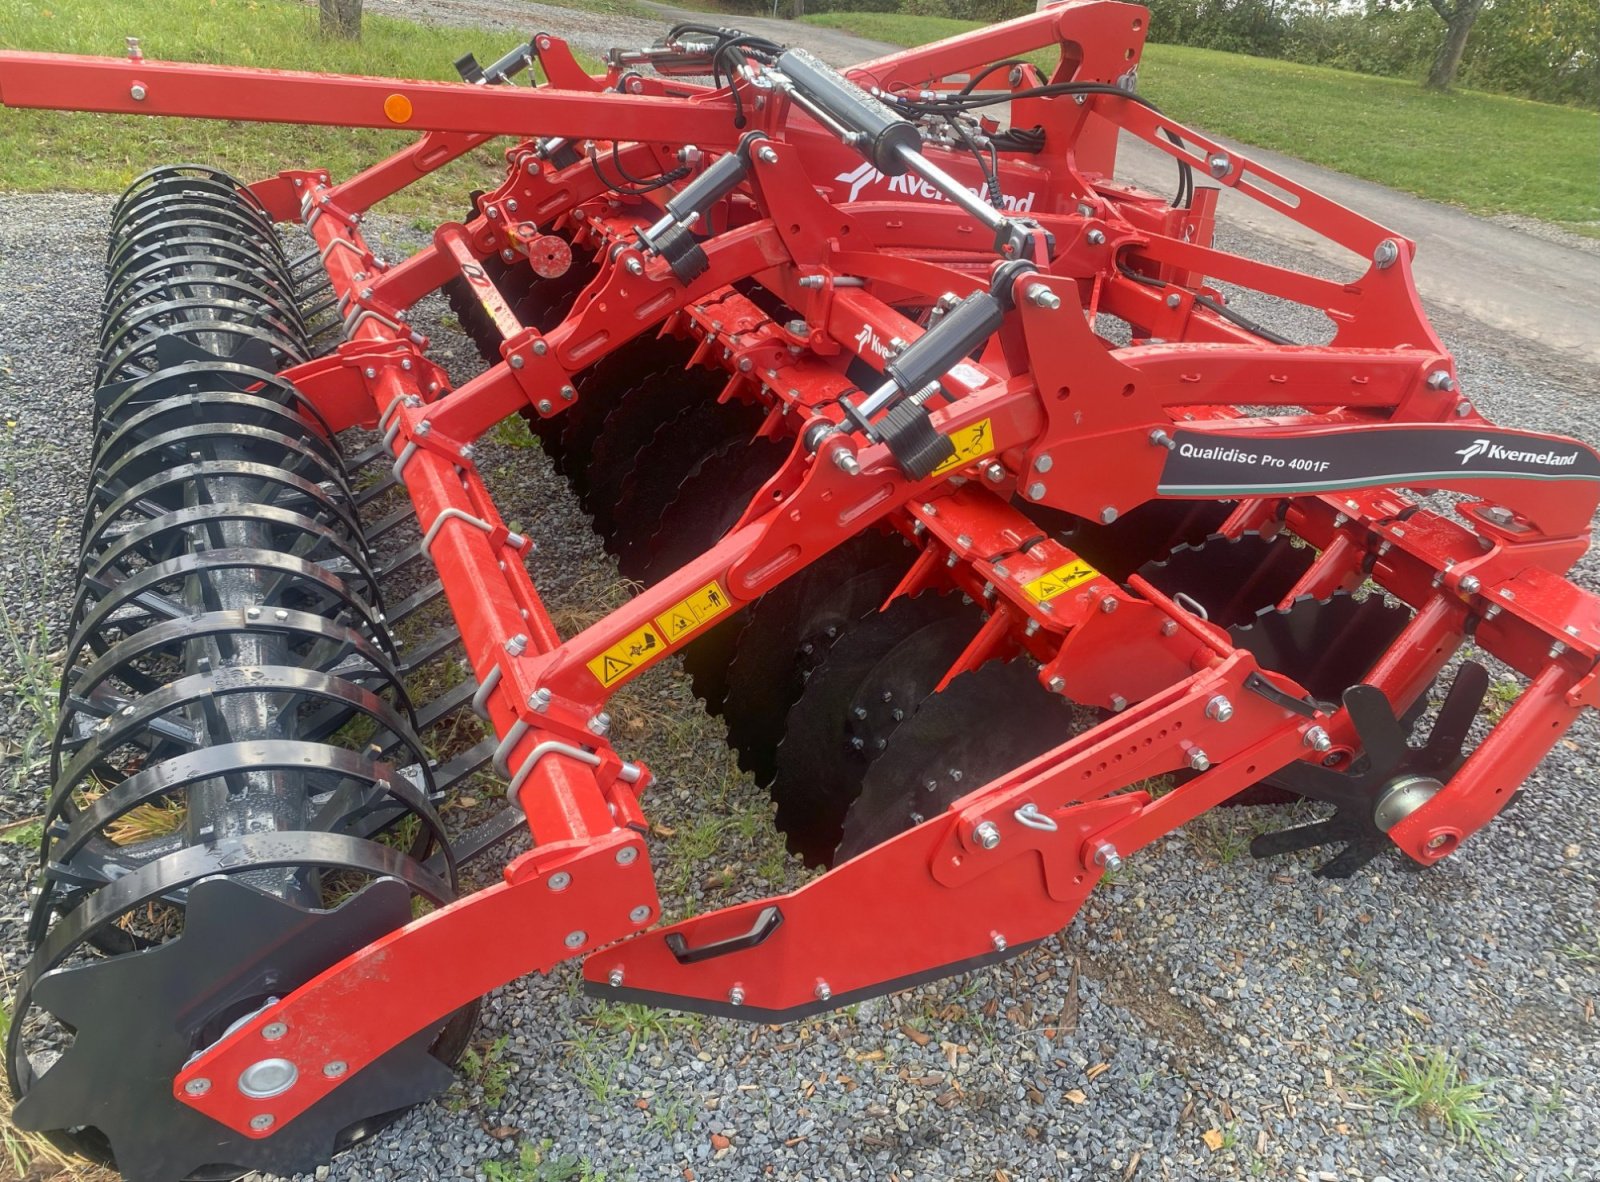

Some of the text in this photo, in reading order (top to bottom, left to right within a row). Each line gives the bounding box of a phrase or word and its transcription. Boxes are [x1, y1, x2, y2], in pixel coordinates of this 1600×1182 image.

[1179, 443, 1330, 473] Qualidisc Pro 4001F
[1487, 444, 1579, 466] Kverneland
